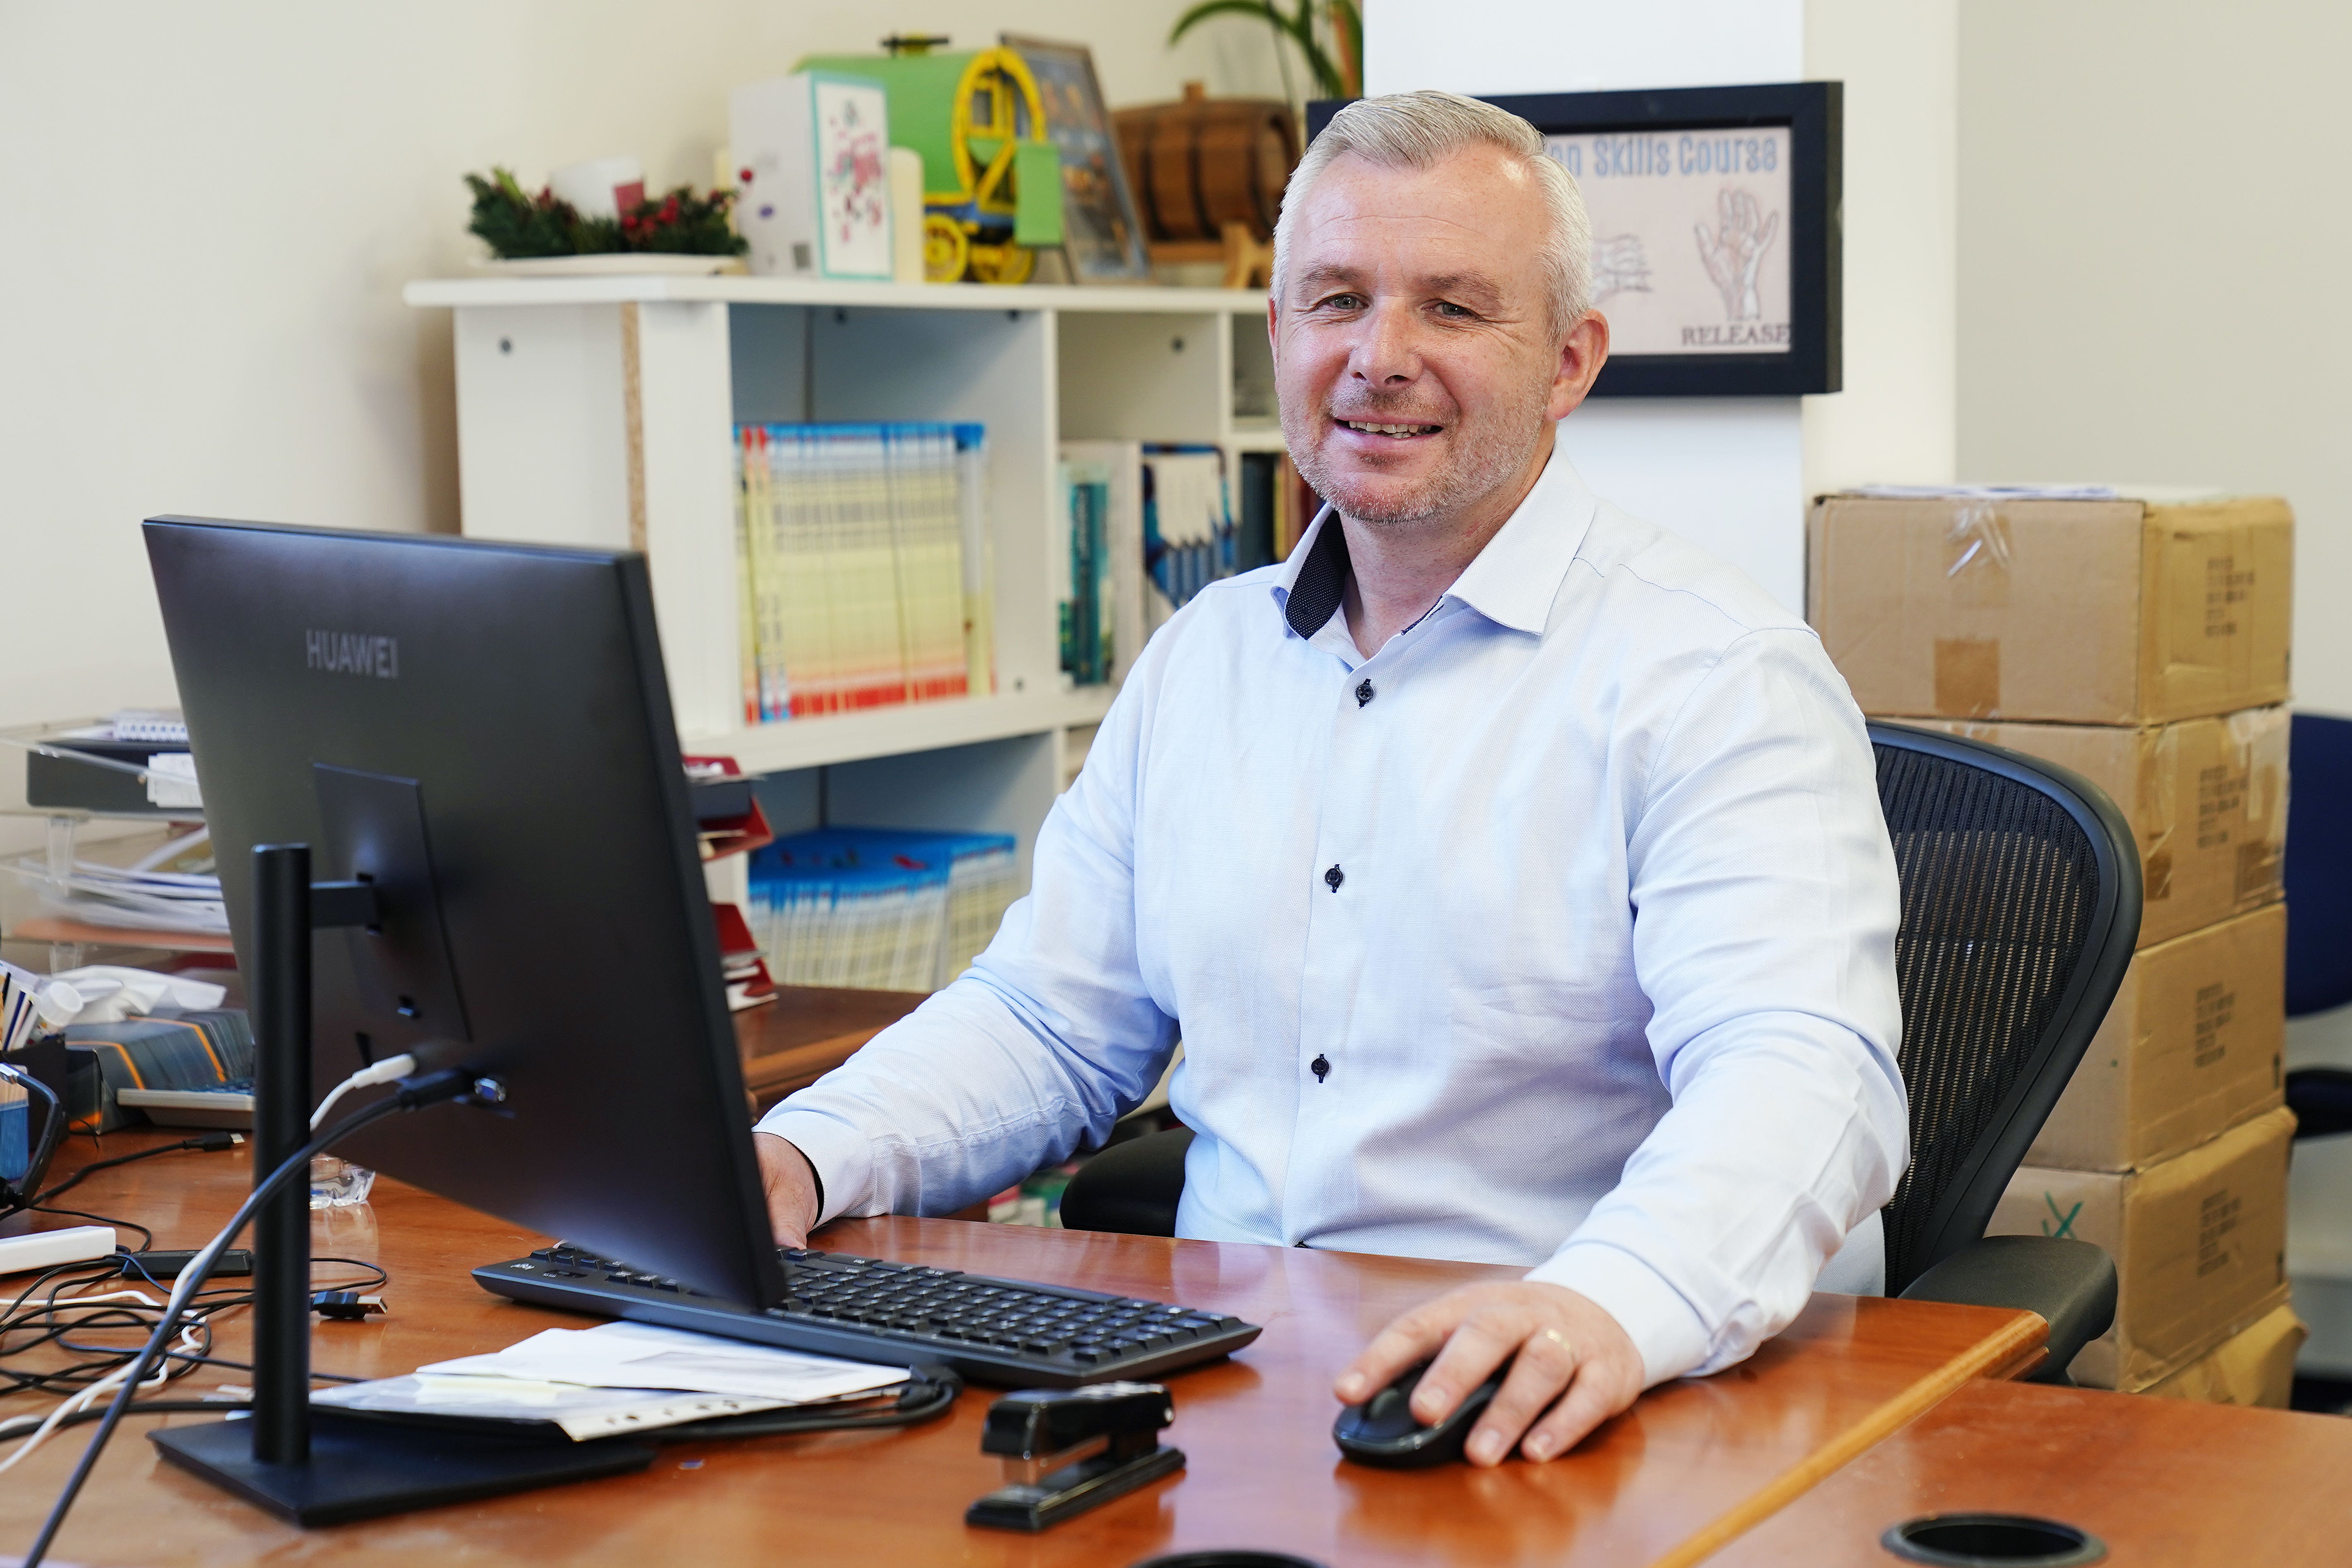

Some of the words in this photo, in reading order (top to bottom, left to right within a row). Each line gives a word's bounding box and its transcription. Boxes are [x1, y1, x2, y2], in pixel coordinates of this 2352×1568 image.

[1593, 135, 1670, 177] Skills
[1678, 136, 1778, 175] Course
[306, 628, 400, 679] HUAWEI
